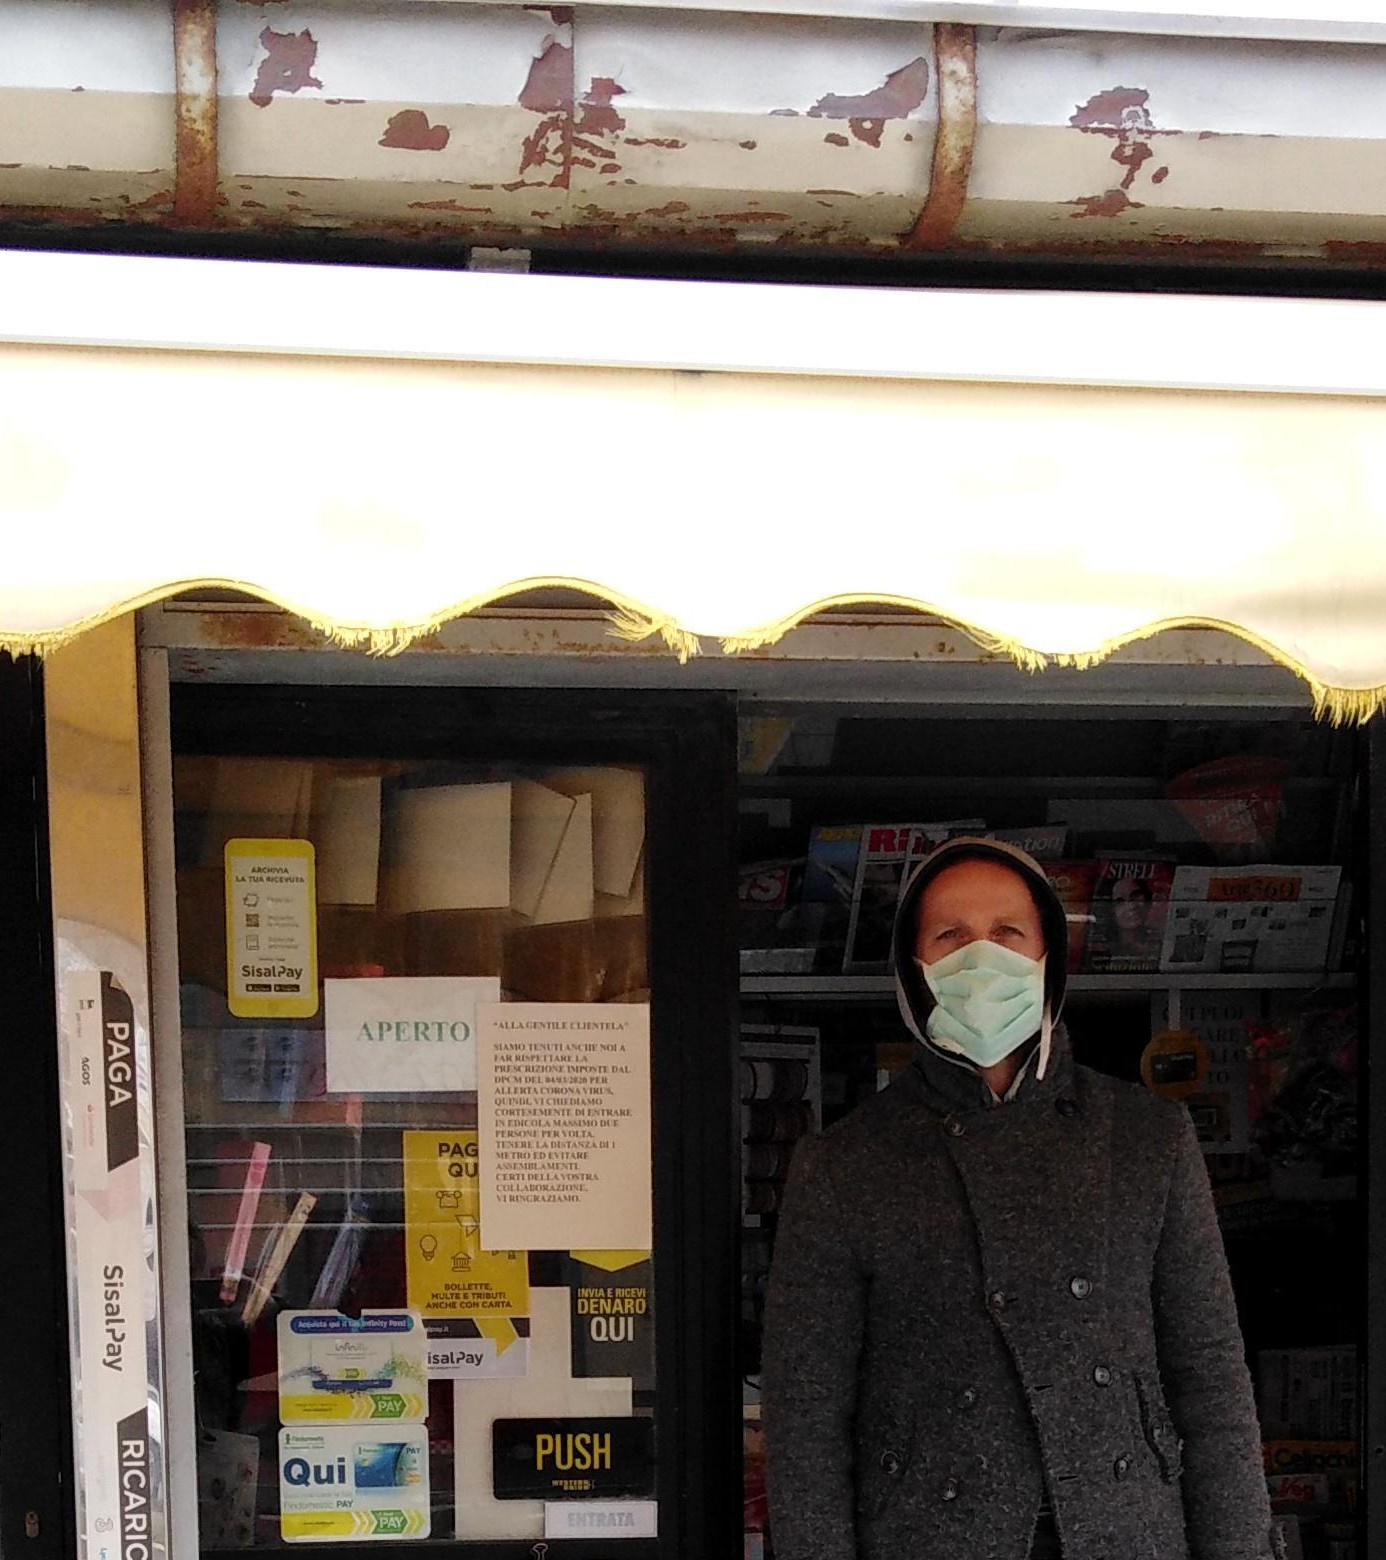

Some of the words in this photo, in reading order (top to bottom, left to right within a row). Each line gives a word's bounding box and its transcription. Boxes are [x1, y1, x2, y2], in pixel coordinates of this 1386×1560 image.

[241, 964, 304, 981] SisalPay
[356, 1020, 471, 1044] APERTO
[106, 1021, 133, 1107] PAGA
[577, 1288, 605, 1298] INVIA
[607, 1288, 613, 1298] E
[615, 1288, 647, 1298] RICEVI
[577, 1298, 648, 1316] DENARO
[102, 1264, 124, 1373] SisalPay
[590, 1316, 635, 1343] QUI
[378, 1401, 402, 1412] PAY
[536, 1432, 611, 1471] PUSH
[283, 1457, 347, 1488] Qui
[379, 1518, 404, 1528] PAY
[567, 1511, 635, 1528] ENTRATA
